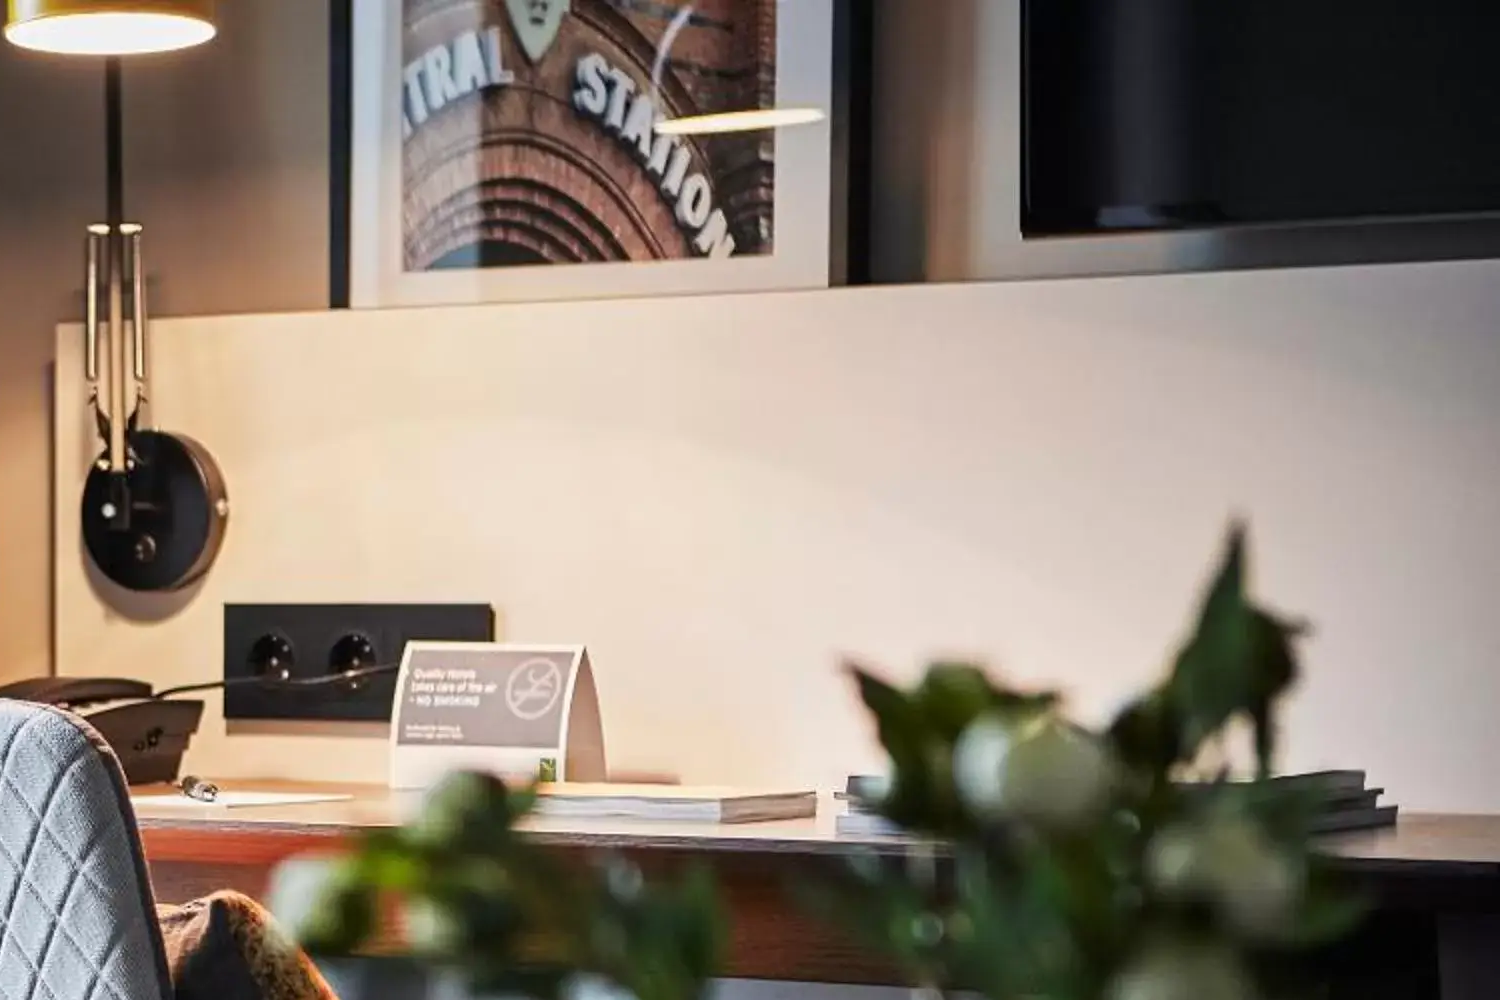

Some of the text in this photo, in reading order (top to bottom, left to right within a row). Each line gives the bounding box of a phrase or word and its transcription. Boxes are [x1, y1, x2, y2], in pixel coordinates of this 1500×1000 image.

[402, 24, 736, 259] TRAL STATION
[416, 695, 432, 707] NO
[434, 695, 480, 708] SMOKING
